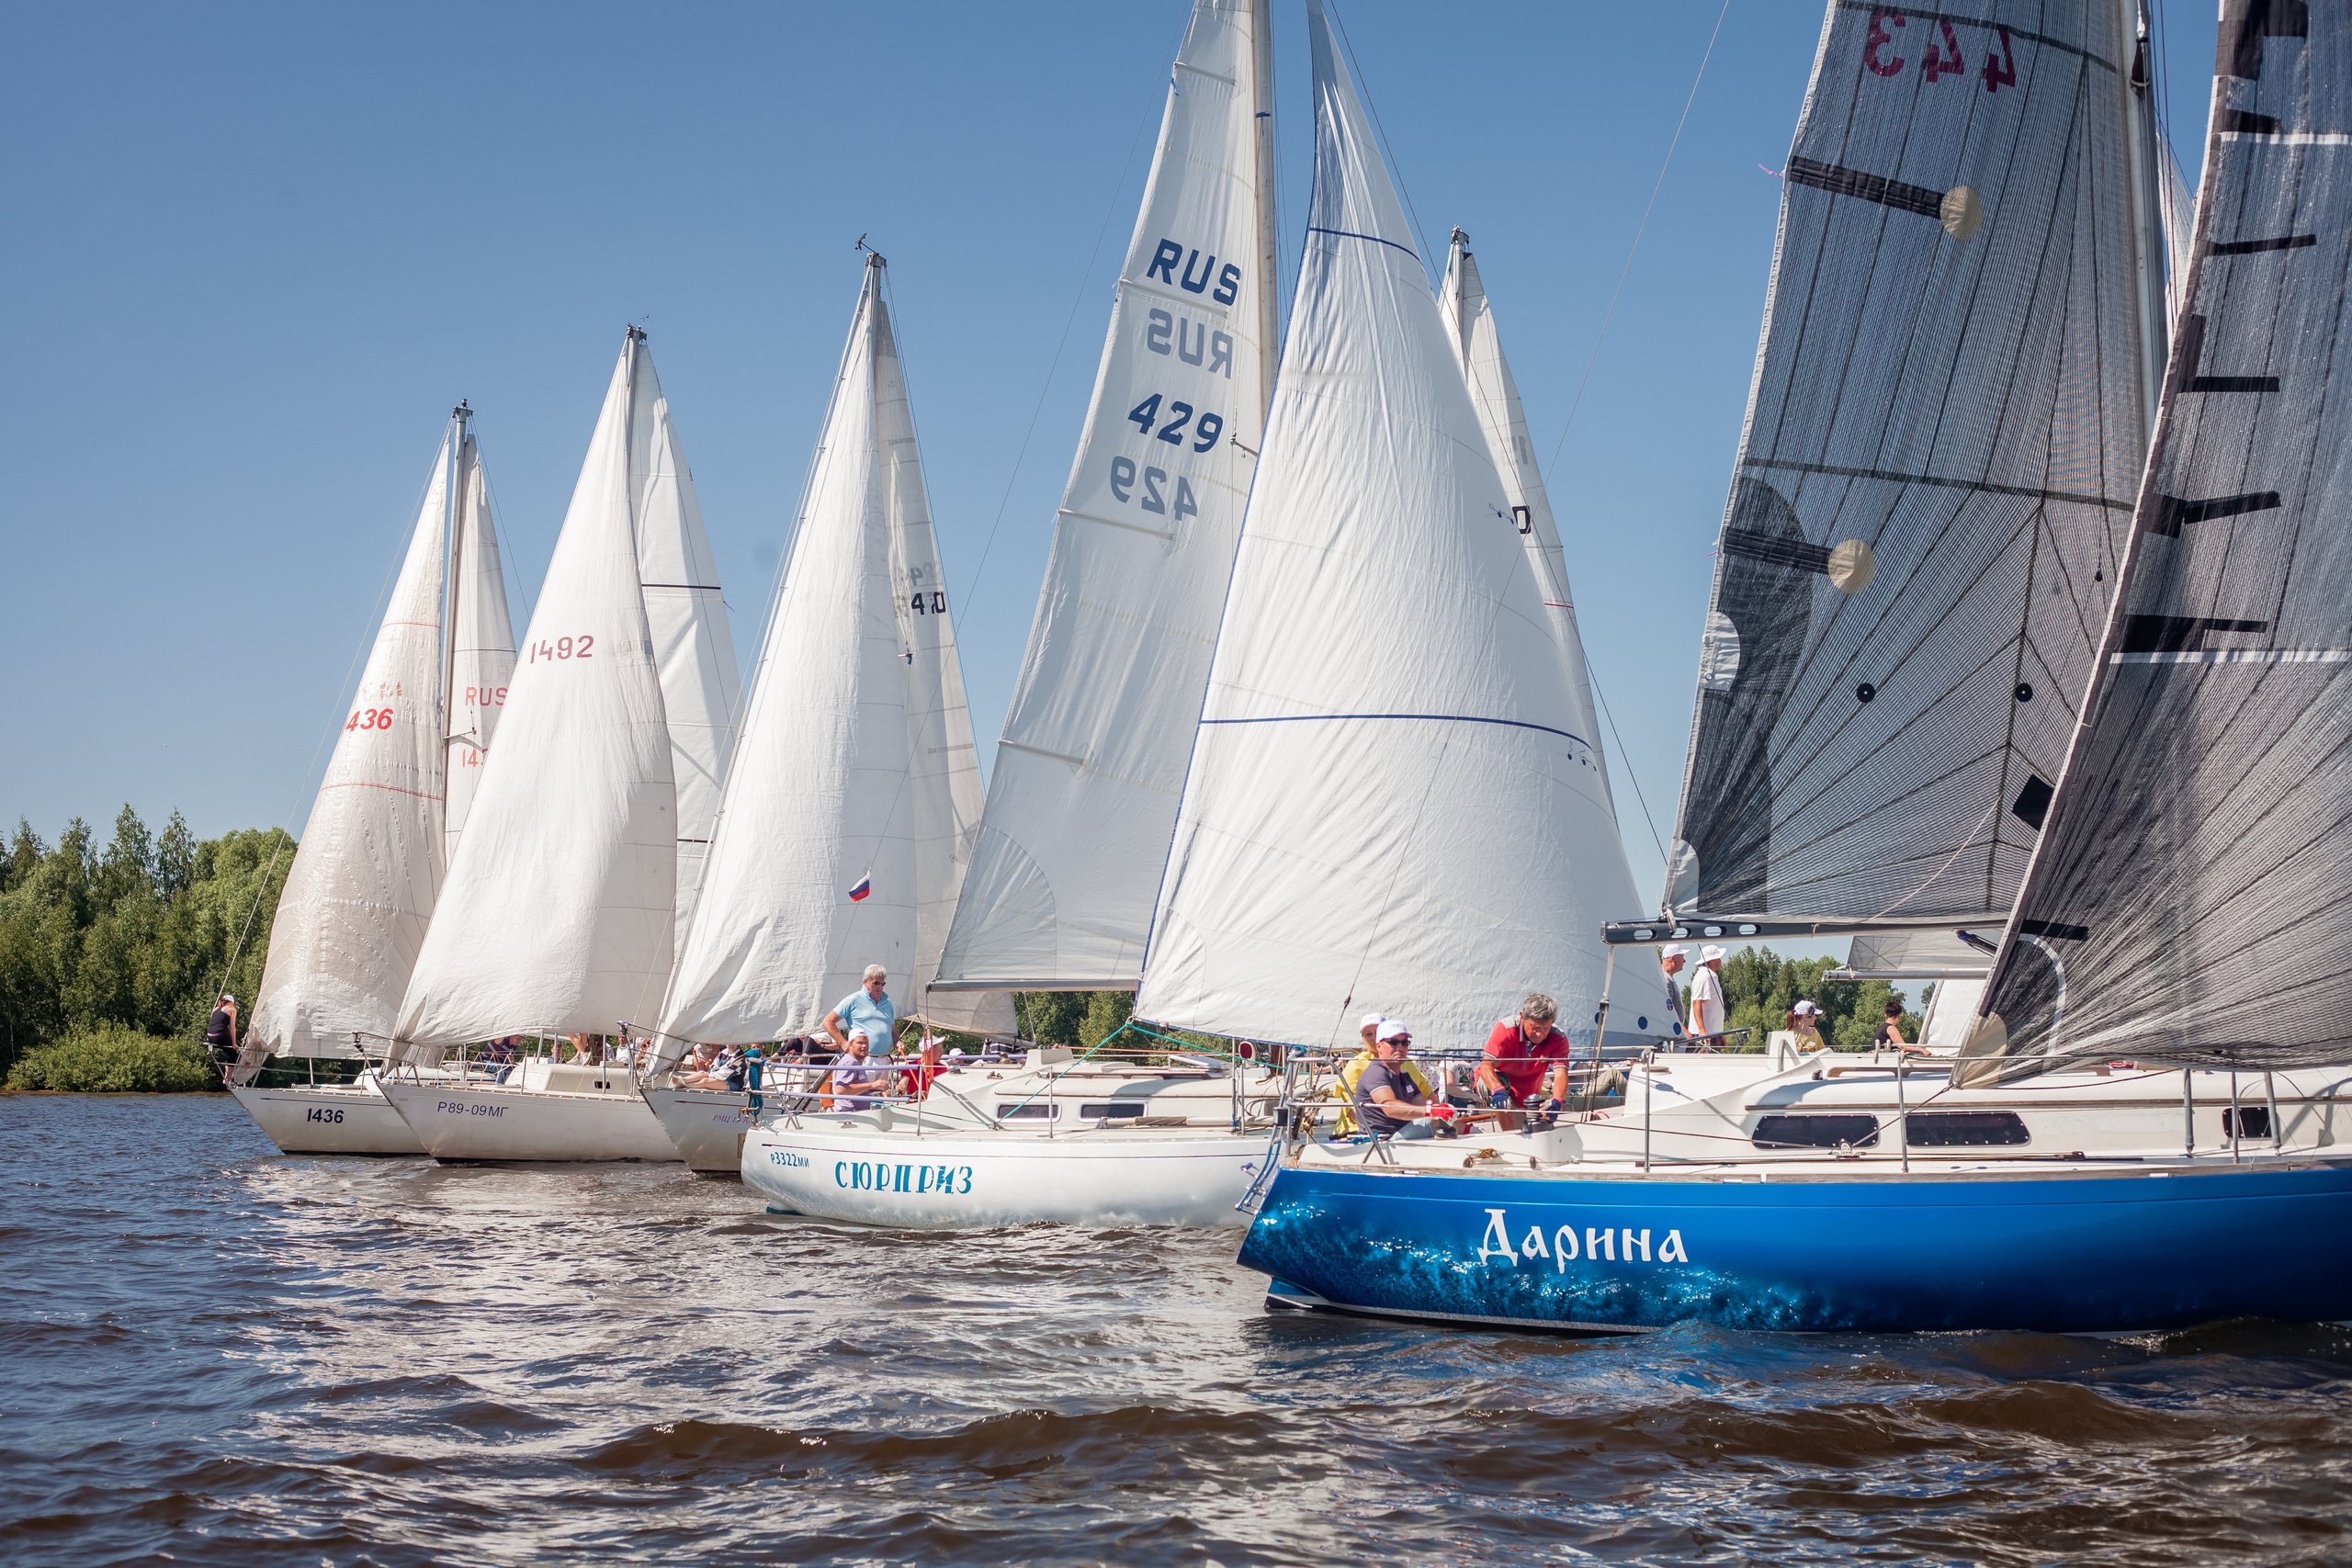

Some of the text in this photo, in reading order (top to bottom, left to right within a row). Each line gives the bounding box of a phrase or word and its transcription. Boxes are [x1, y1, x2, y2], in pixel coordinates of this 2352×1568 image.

[1147, 238, 1241, 307] RUS
[1128, 393, 1223, 453] 429
[530, 635, 594, 664] 1492
[465, 686, 508, 706] RUS
[307, 1108, 344, 1123] 1436
[770, 1151, 810, 1168] Р3322МИ
[834, 1160, 973, 1194] СЮРПРИЗ
[1477, 1208, 1689, 1274] Дарина
